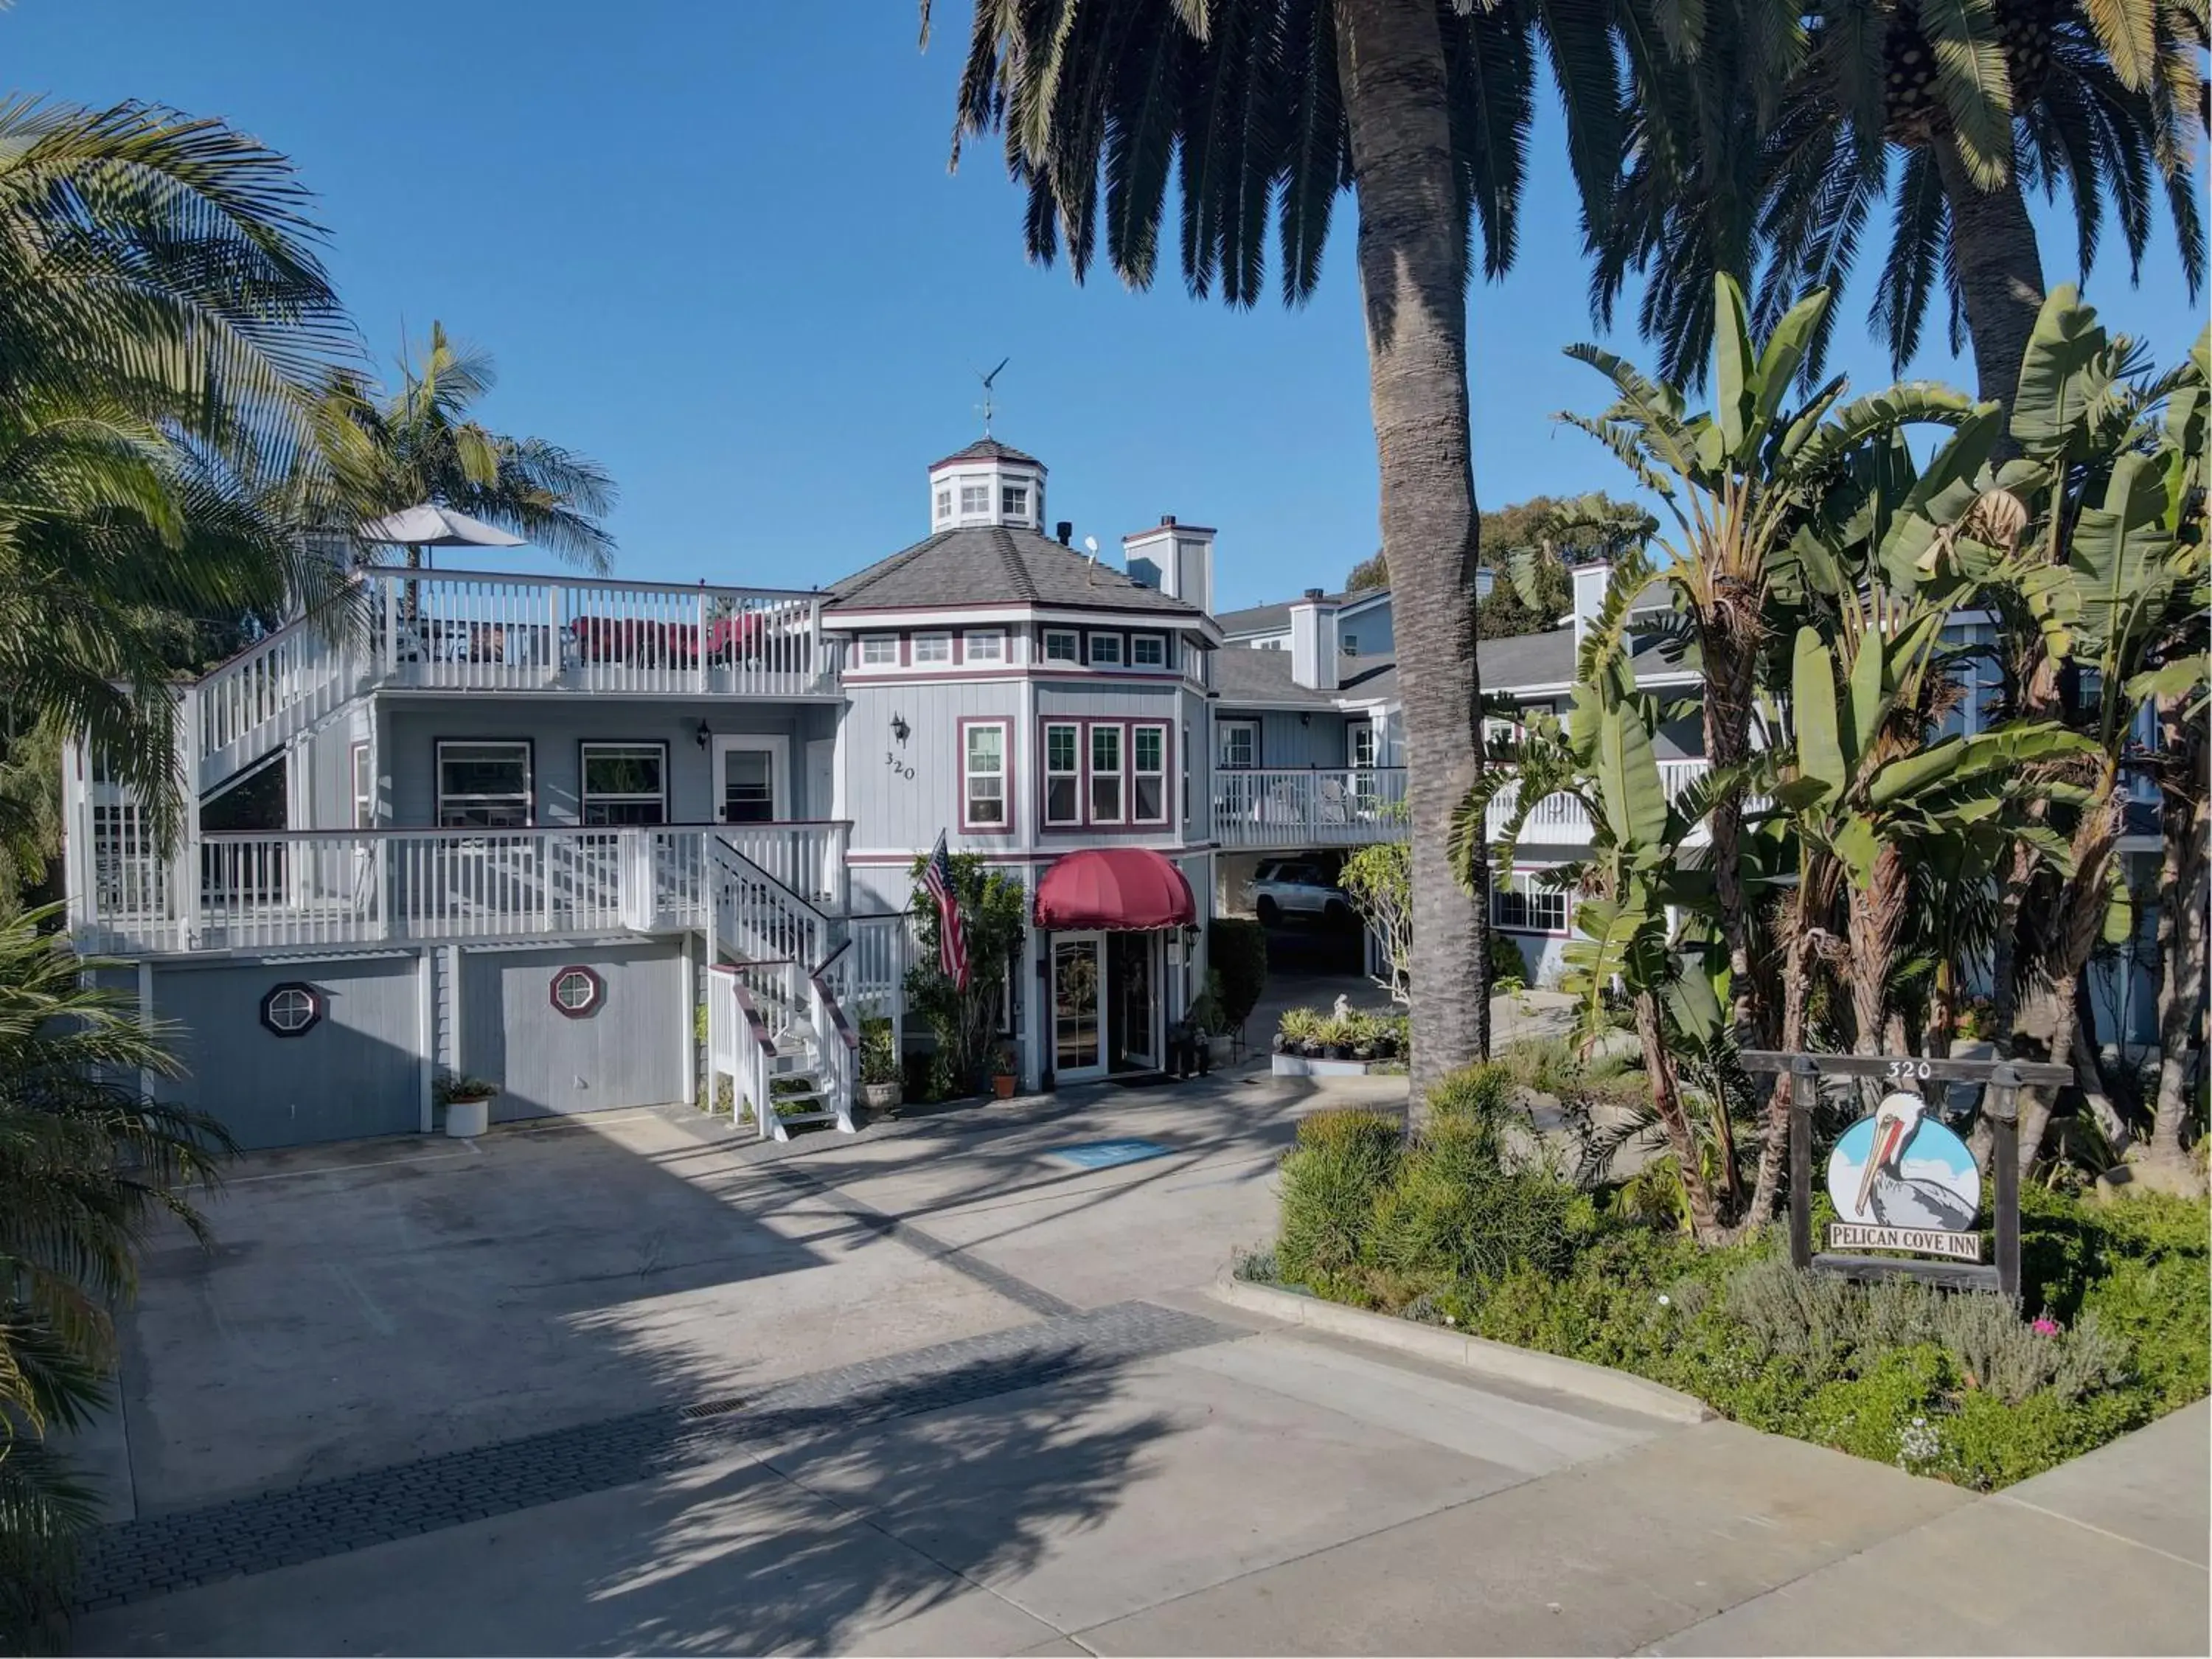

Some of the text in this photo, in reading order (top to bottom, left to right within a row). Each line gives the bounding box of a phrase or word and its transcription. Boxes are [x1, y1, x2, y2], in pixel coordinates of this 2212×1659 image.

[885, 752, 915, 780] 320
[1886, 1061, 1931, 1079] 320
[1833, 1226, 1977, 1256] PELICAN COVE INN
